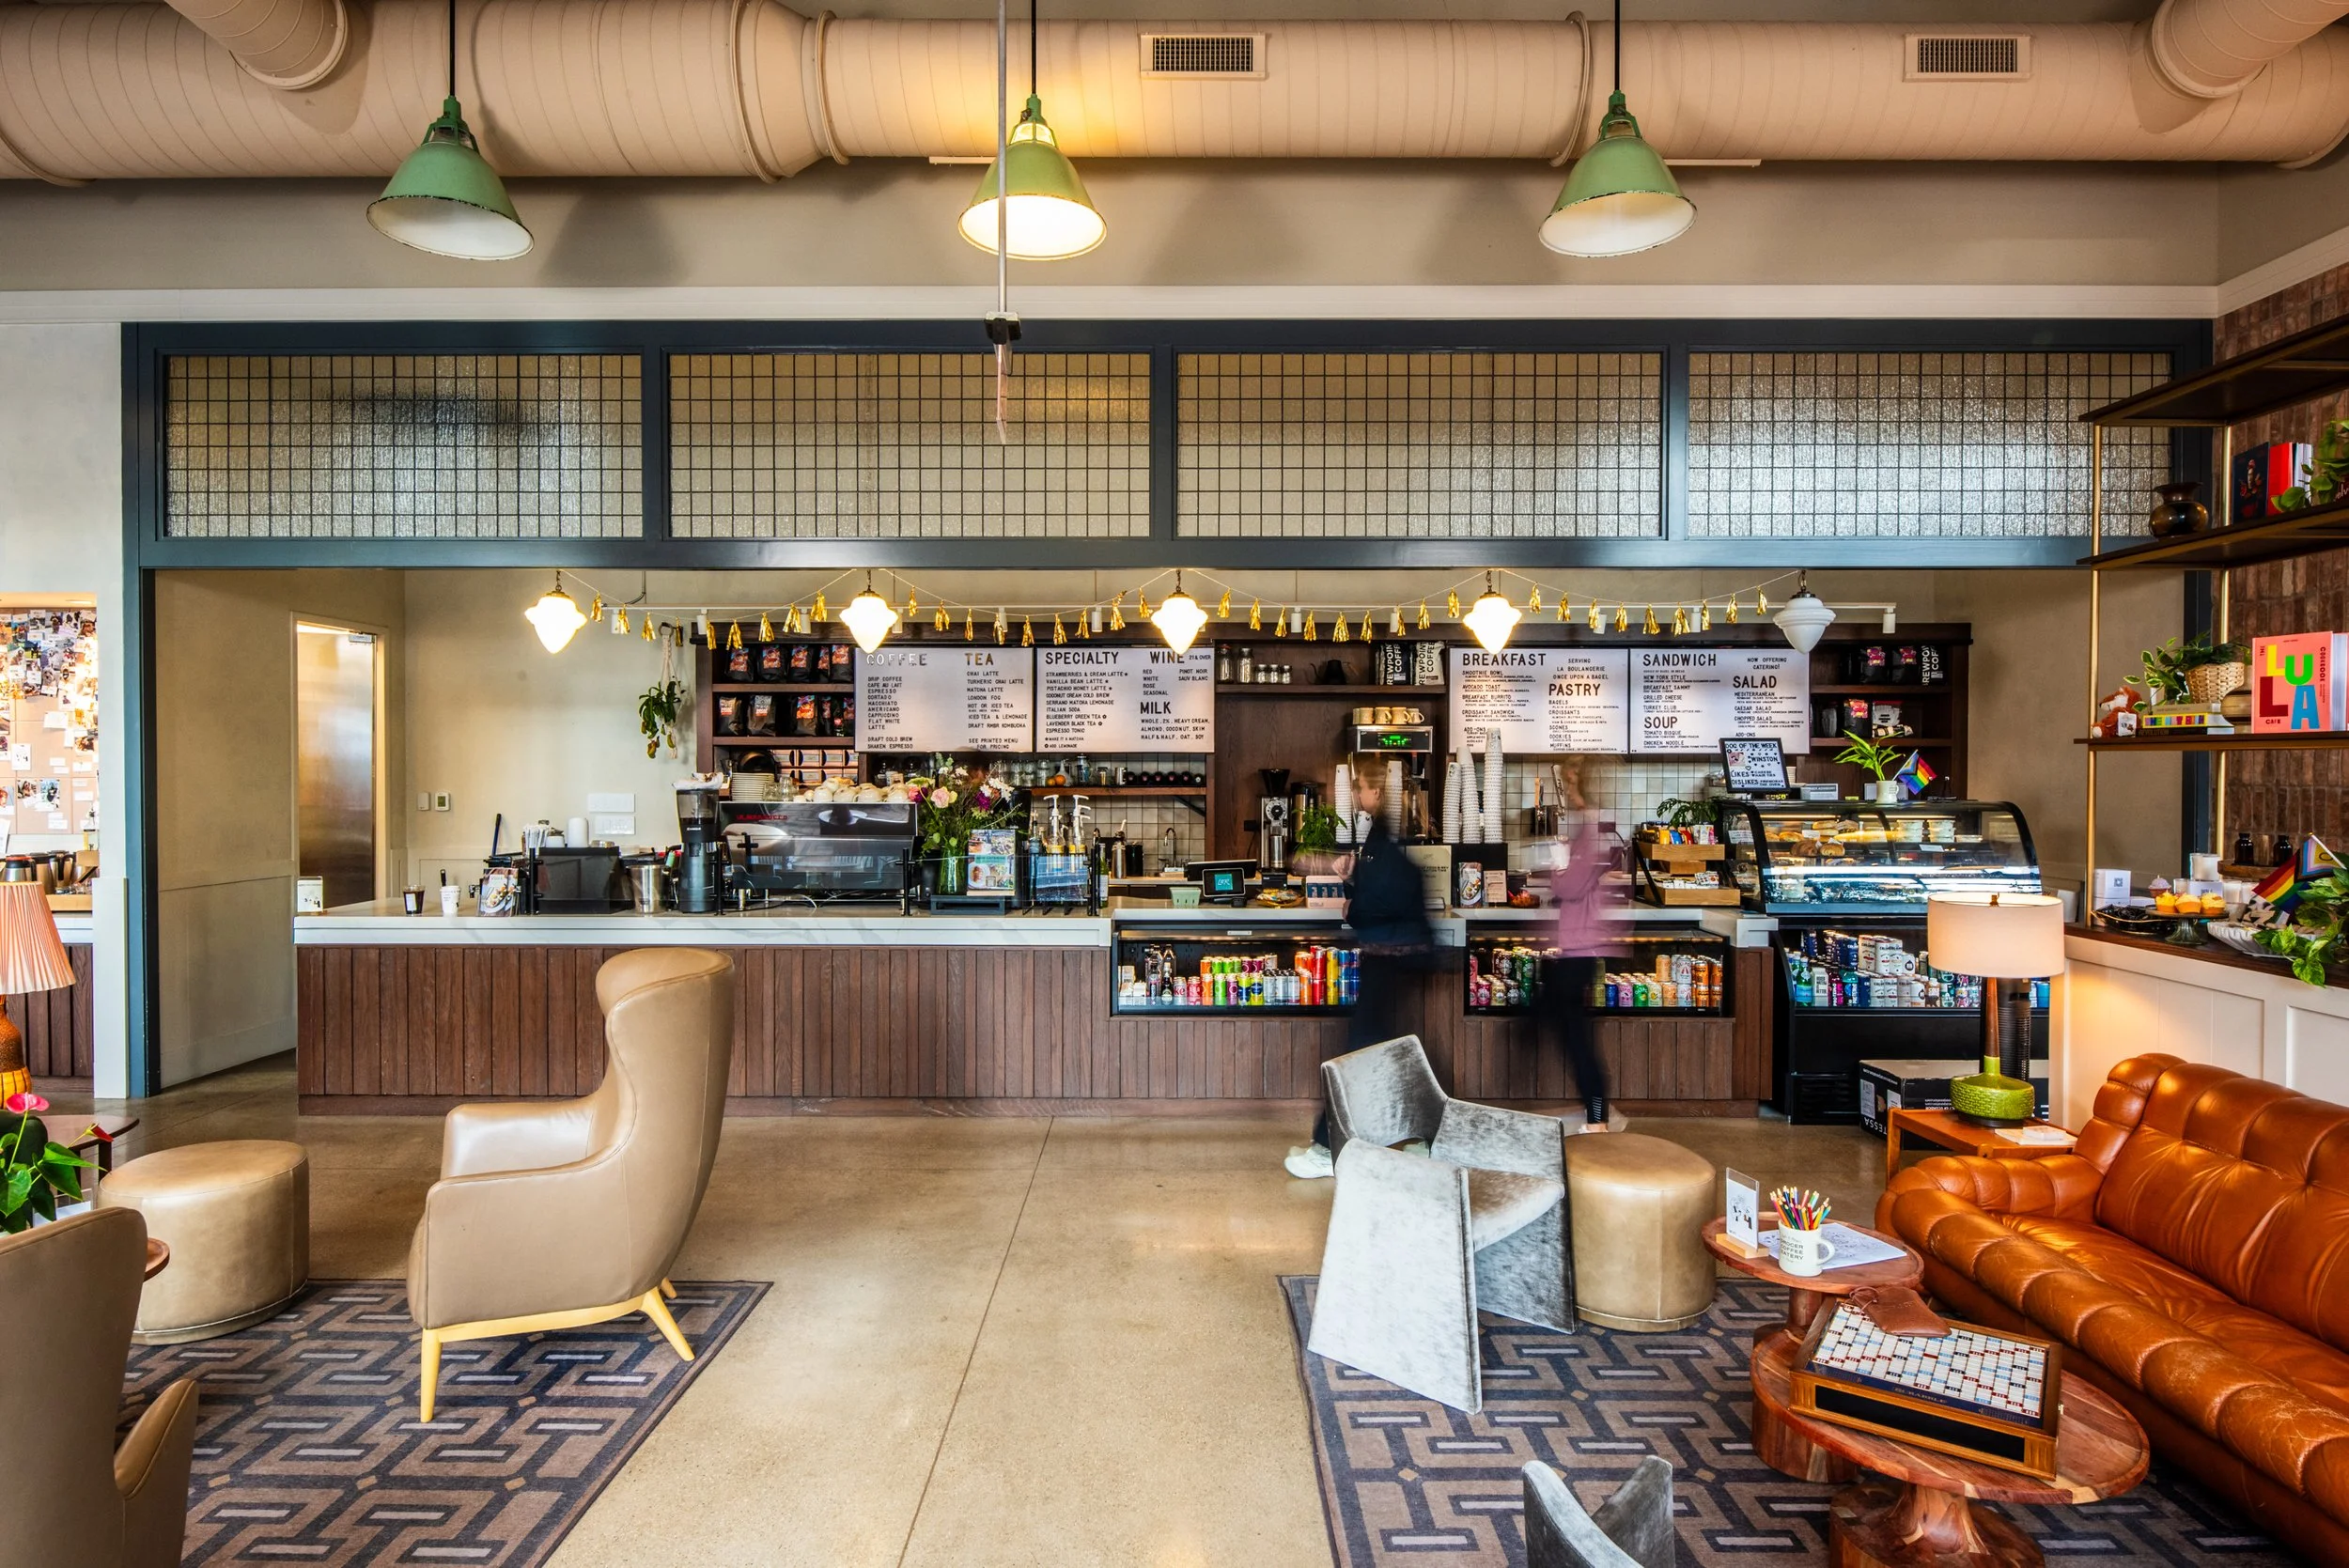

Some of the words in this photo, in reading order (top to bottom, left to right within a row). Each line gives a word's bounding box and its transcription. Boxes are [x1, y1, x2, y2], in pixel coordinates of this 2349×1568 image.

[867, 653, 928, 666] COFFEE
[964, 653, 994, 666] TEA
[1045, 651, 1119, 665] SPECIALTY
[1150, 651, 1185, 664] WINE
[1463, 653, 1546, 666] BREAKFAST
[1643, 654, 1716, 666] SANDWICH
[1733, 676, 1777, 688] SALAD
[1549, 683, 1600, 696] PASTRY
[1140, 701, 1171, 714] MILK
[1644, 716, 1678, 729] SOUP
